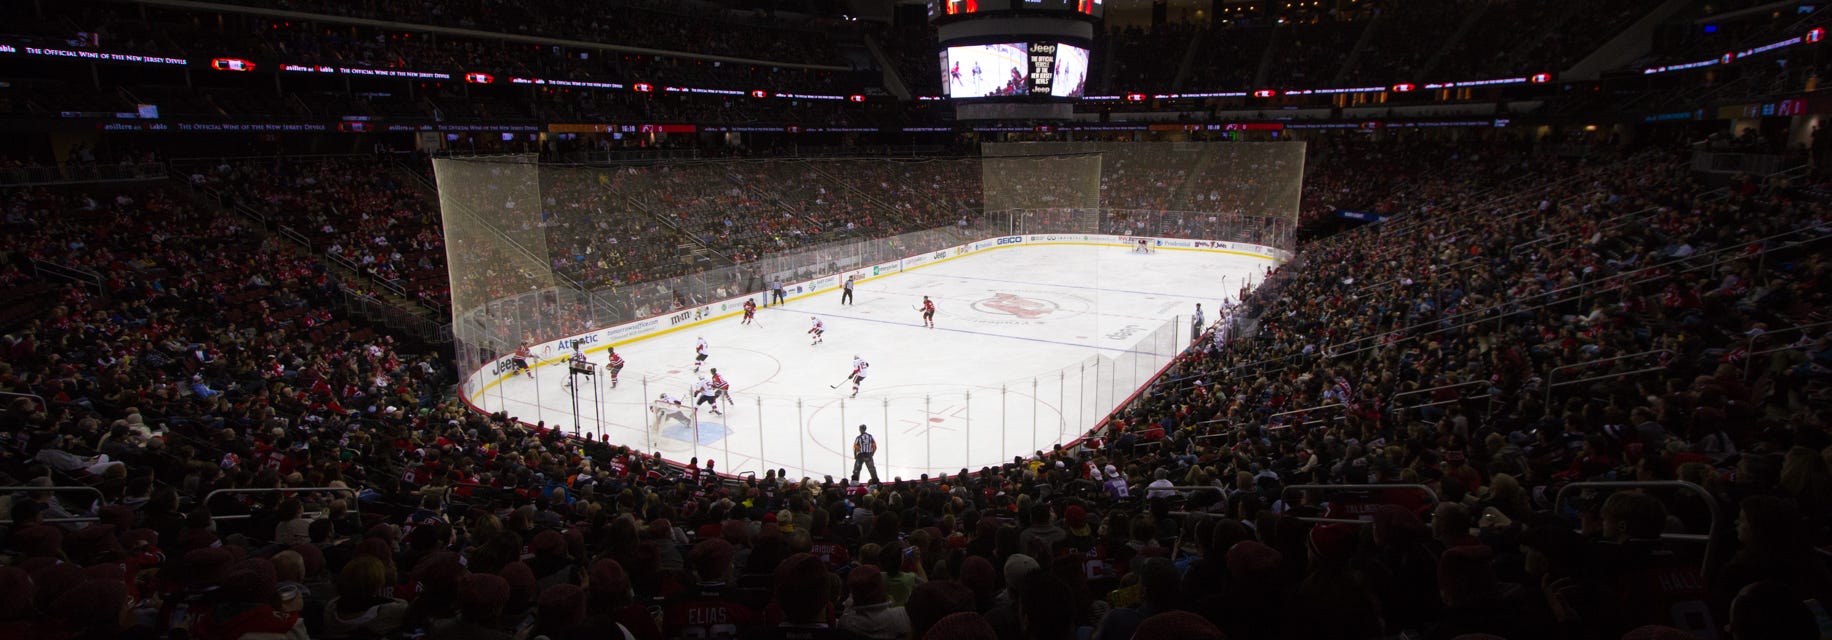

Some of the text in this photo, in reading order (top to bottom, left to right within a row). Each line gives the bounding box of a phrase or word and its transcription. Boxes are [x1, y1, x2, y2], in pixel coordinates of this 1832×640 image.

[43, 48, 78, 57] OFFICIAL
[1030, 43, 1056, 54] Jeep
[997, 237, 1022, 245] GEICO
[934, 251, 947, 260] Jeep
[558, 334, 599, 351] Atltic
[688, 607, 729, 624] ELIAS
